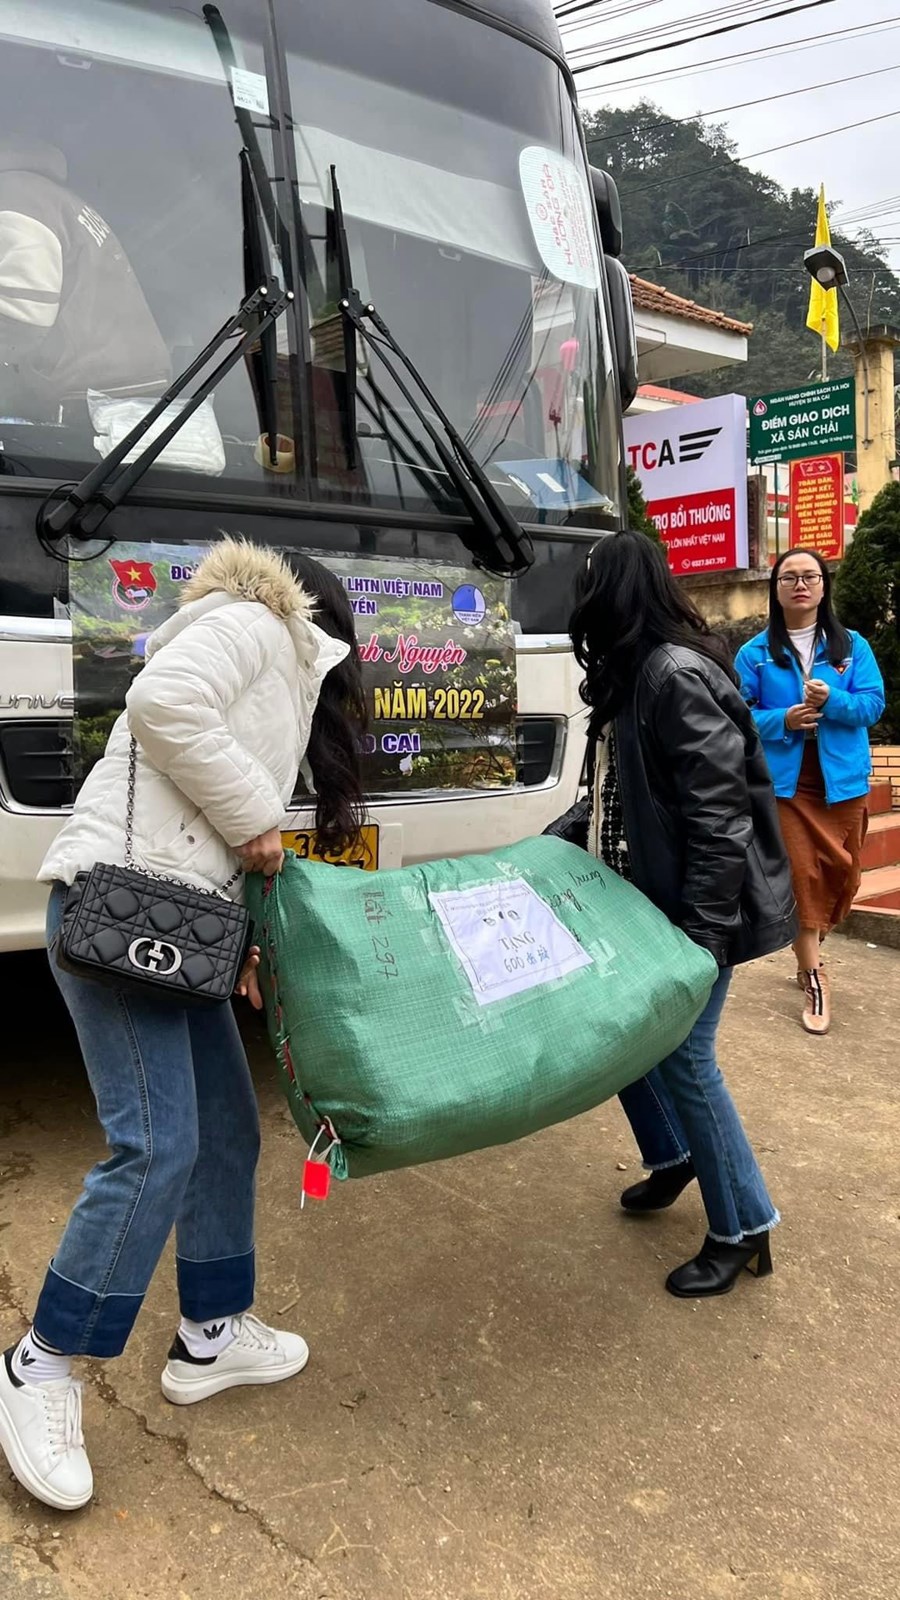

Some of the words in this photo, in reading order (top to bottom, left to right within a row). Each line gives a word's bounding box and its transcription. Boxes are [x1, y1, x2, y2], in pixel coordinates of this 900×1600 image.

[761, 414, 787, 431] ĐIỂM
[789, 410, 819, 426] GIAO
[821, 404, 850, 419] DỊCH
[770, 430, 785, 444] XÃ
[787, 425, 809, 441] SÁN
[812, 420, 839, 437] CHẢI
[627, 438, 676, 472] TCA
[652, 512, 669, 535] TRỢ
[670, 503, 687, 529] BỒI
[688, 501, 731, 526] THƯỜNG
[800, 525, 819, 533] THAM
[683, 534, 699, 547] NHẤT
[698, 533, 712, 546] VIỆT
[712, 532, 726, 543] NAM
[171, 563, 199, 580] ĐO
[347, 577, 380, 593] LHTN
[383, 577, 411, 597] VIỆT
[413, 582, 443, 597] NAM
[357, 633, 384, 662] nh
[384, 634, 468, 674] Nguyện
[373, 681, 428, 720] NĂM
[433, 688, 486, 720] 2022
[382, 733, 422, 754] CAI
[371, 935, 400, 980] 297
[503, 955, 526, 974] 600
